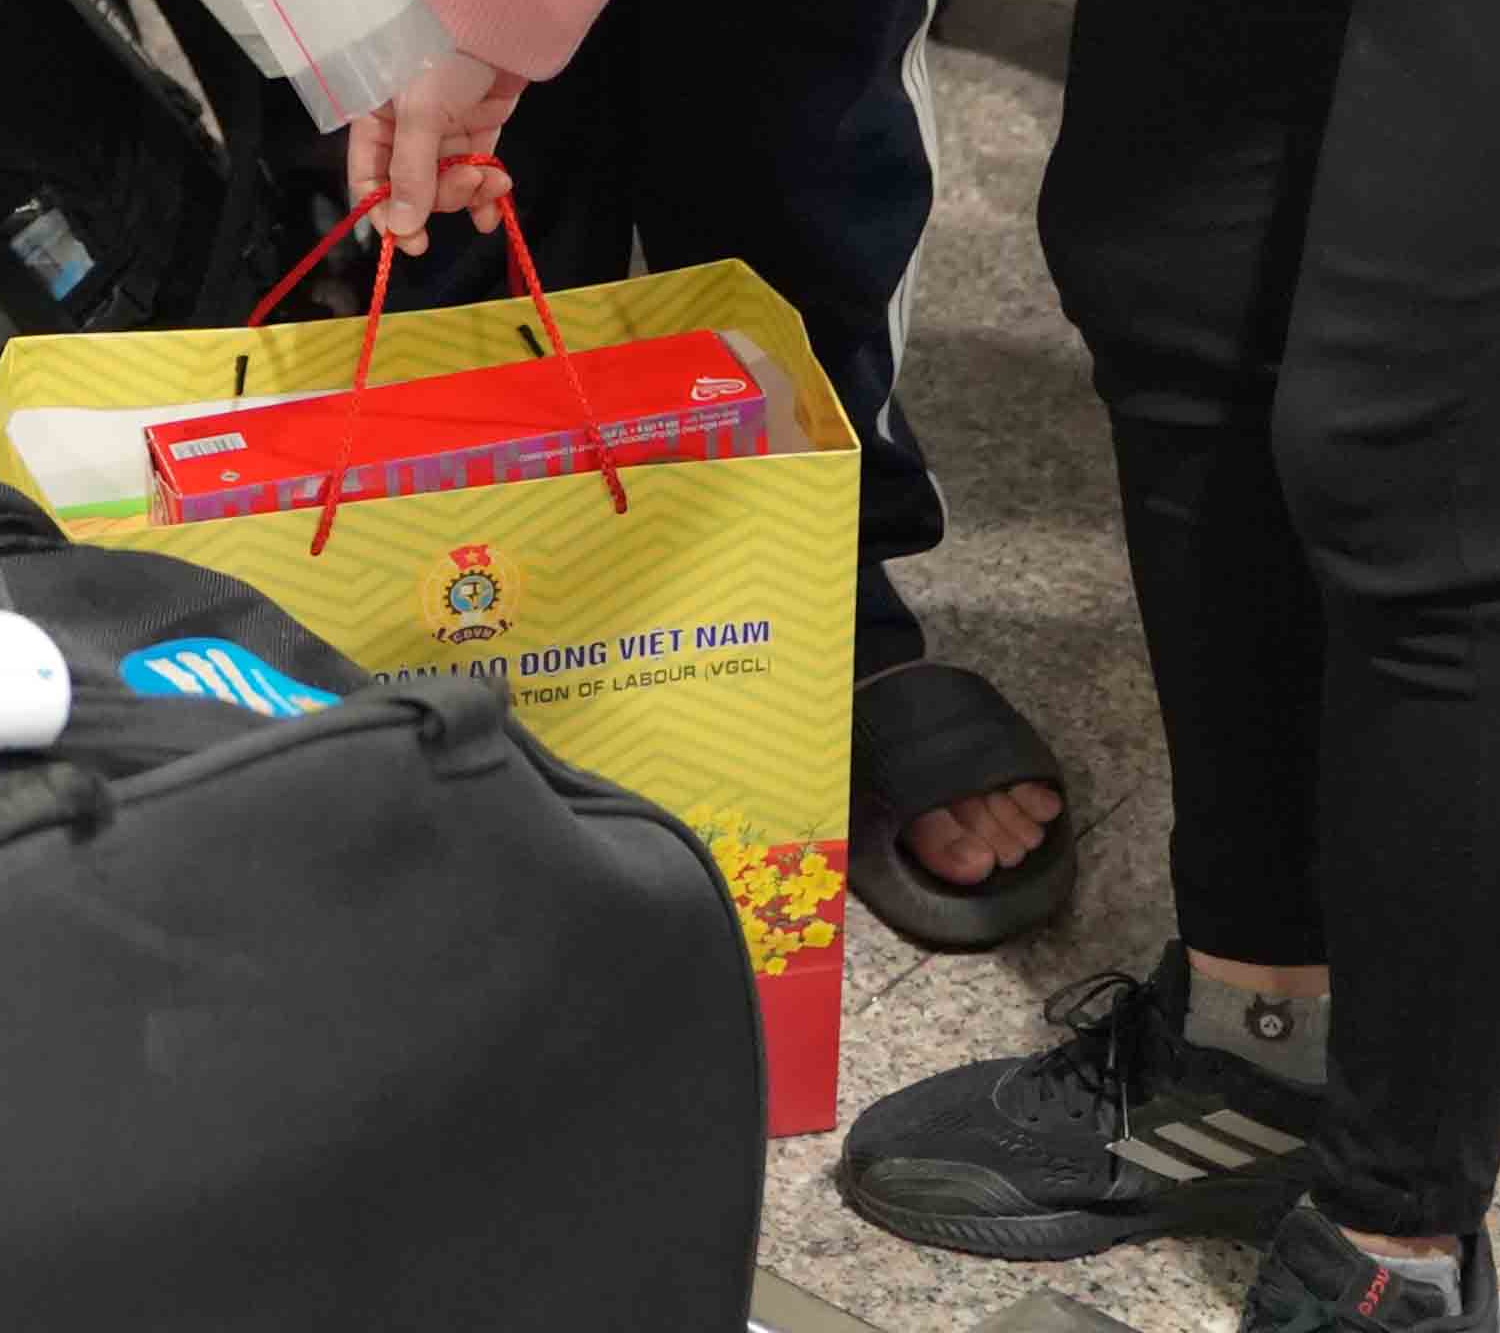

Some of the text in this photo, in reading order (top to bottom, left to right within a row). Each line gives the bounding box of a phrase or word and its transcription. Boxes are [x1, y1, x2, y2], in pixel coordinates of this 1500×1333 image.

[619, 628, 684, 661] VIỆT
[695, 620, 770, 648] NAM
[578, 681, 604, 699] OF
[613, 664, 697, 692] LABOUR
[704, 656, 772, 681] (VGCL)
